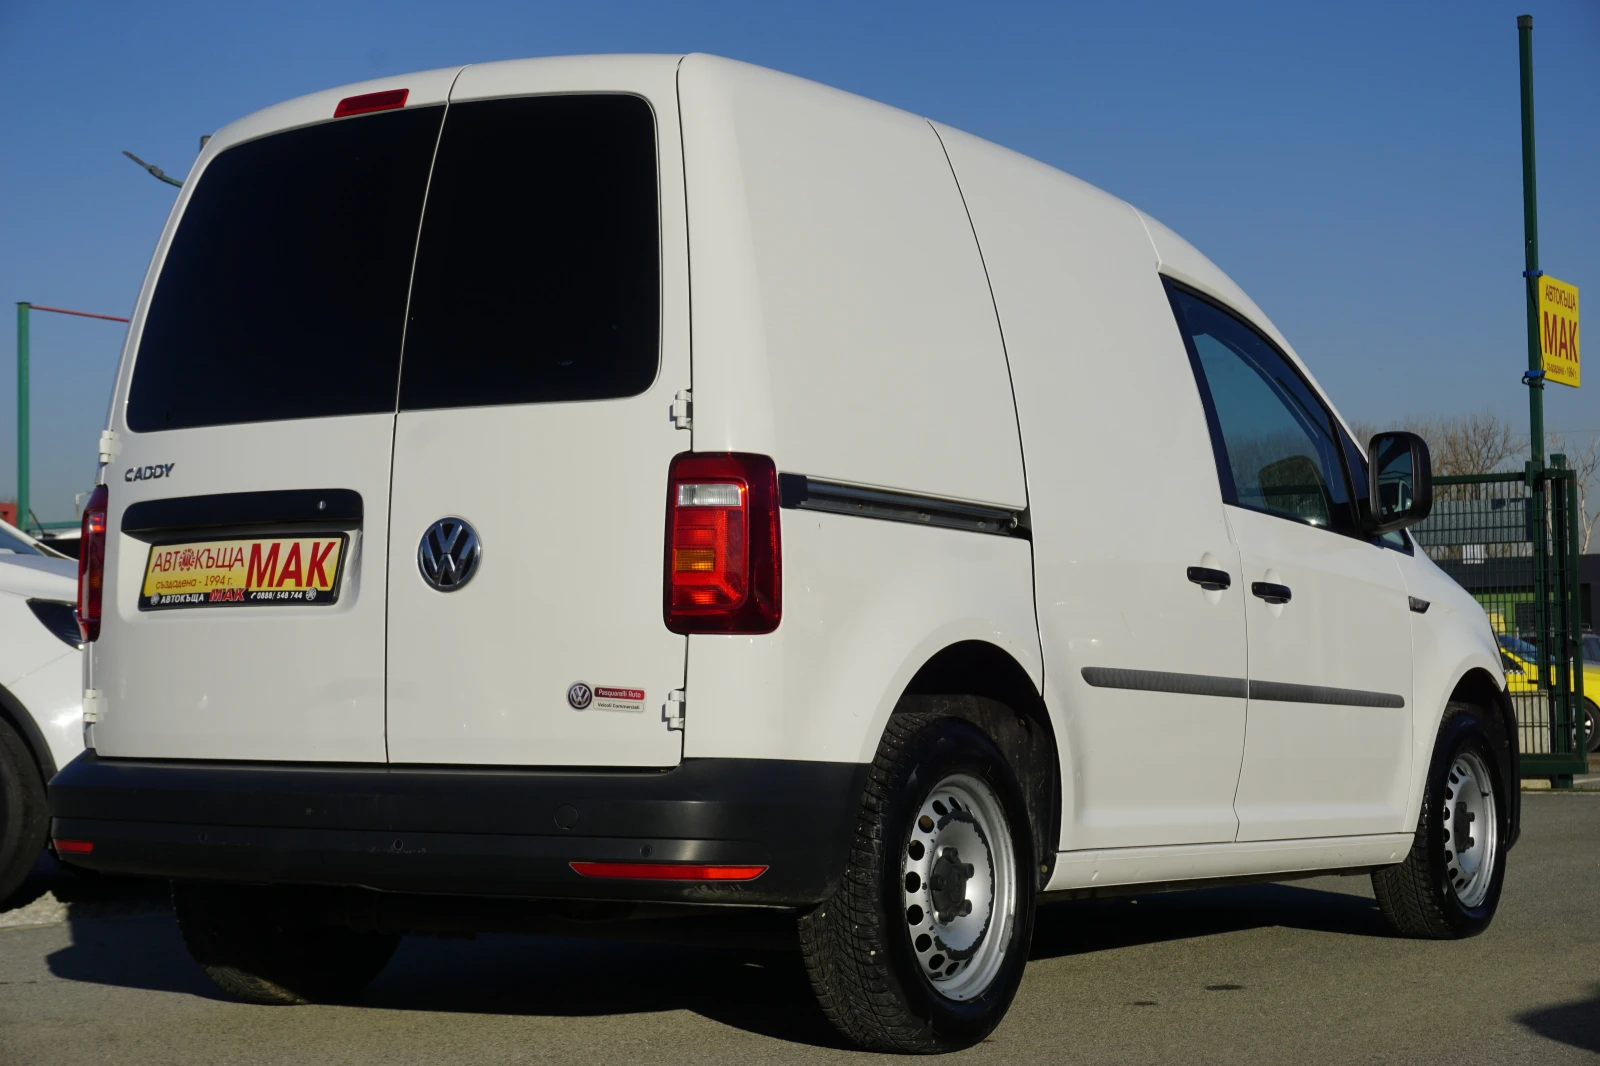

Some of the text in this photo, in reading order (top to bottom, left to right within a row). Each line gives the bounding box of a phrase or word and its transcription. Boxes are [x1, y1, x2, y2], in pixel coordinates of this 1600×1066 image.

[1545, 284, 1577, 312] АВТОКЪЩА
[1543, 311, 1578, 363] МАК
[125, 462, 175, 482] CADDY
[245, 541, 336, 588] МАК
[204, 575, 226, 587] 1994
[160, 593, 204, 604] АВТОКЪЩА
[209, 588, 246, 602] МАК
[290, 591, 303, 599] 744
